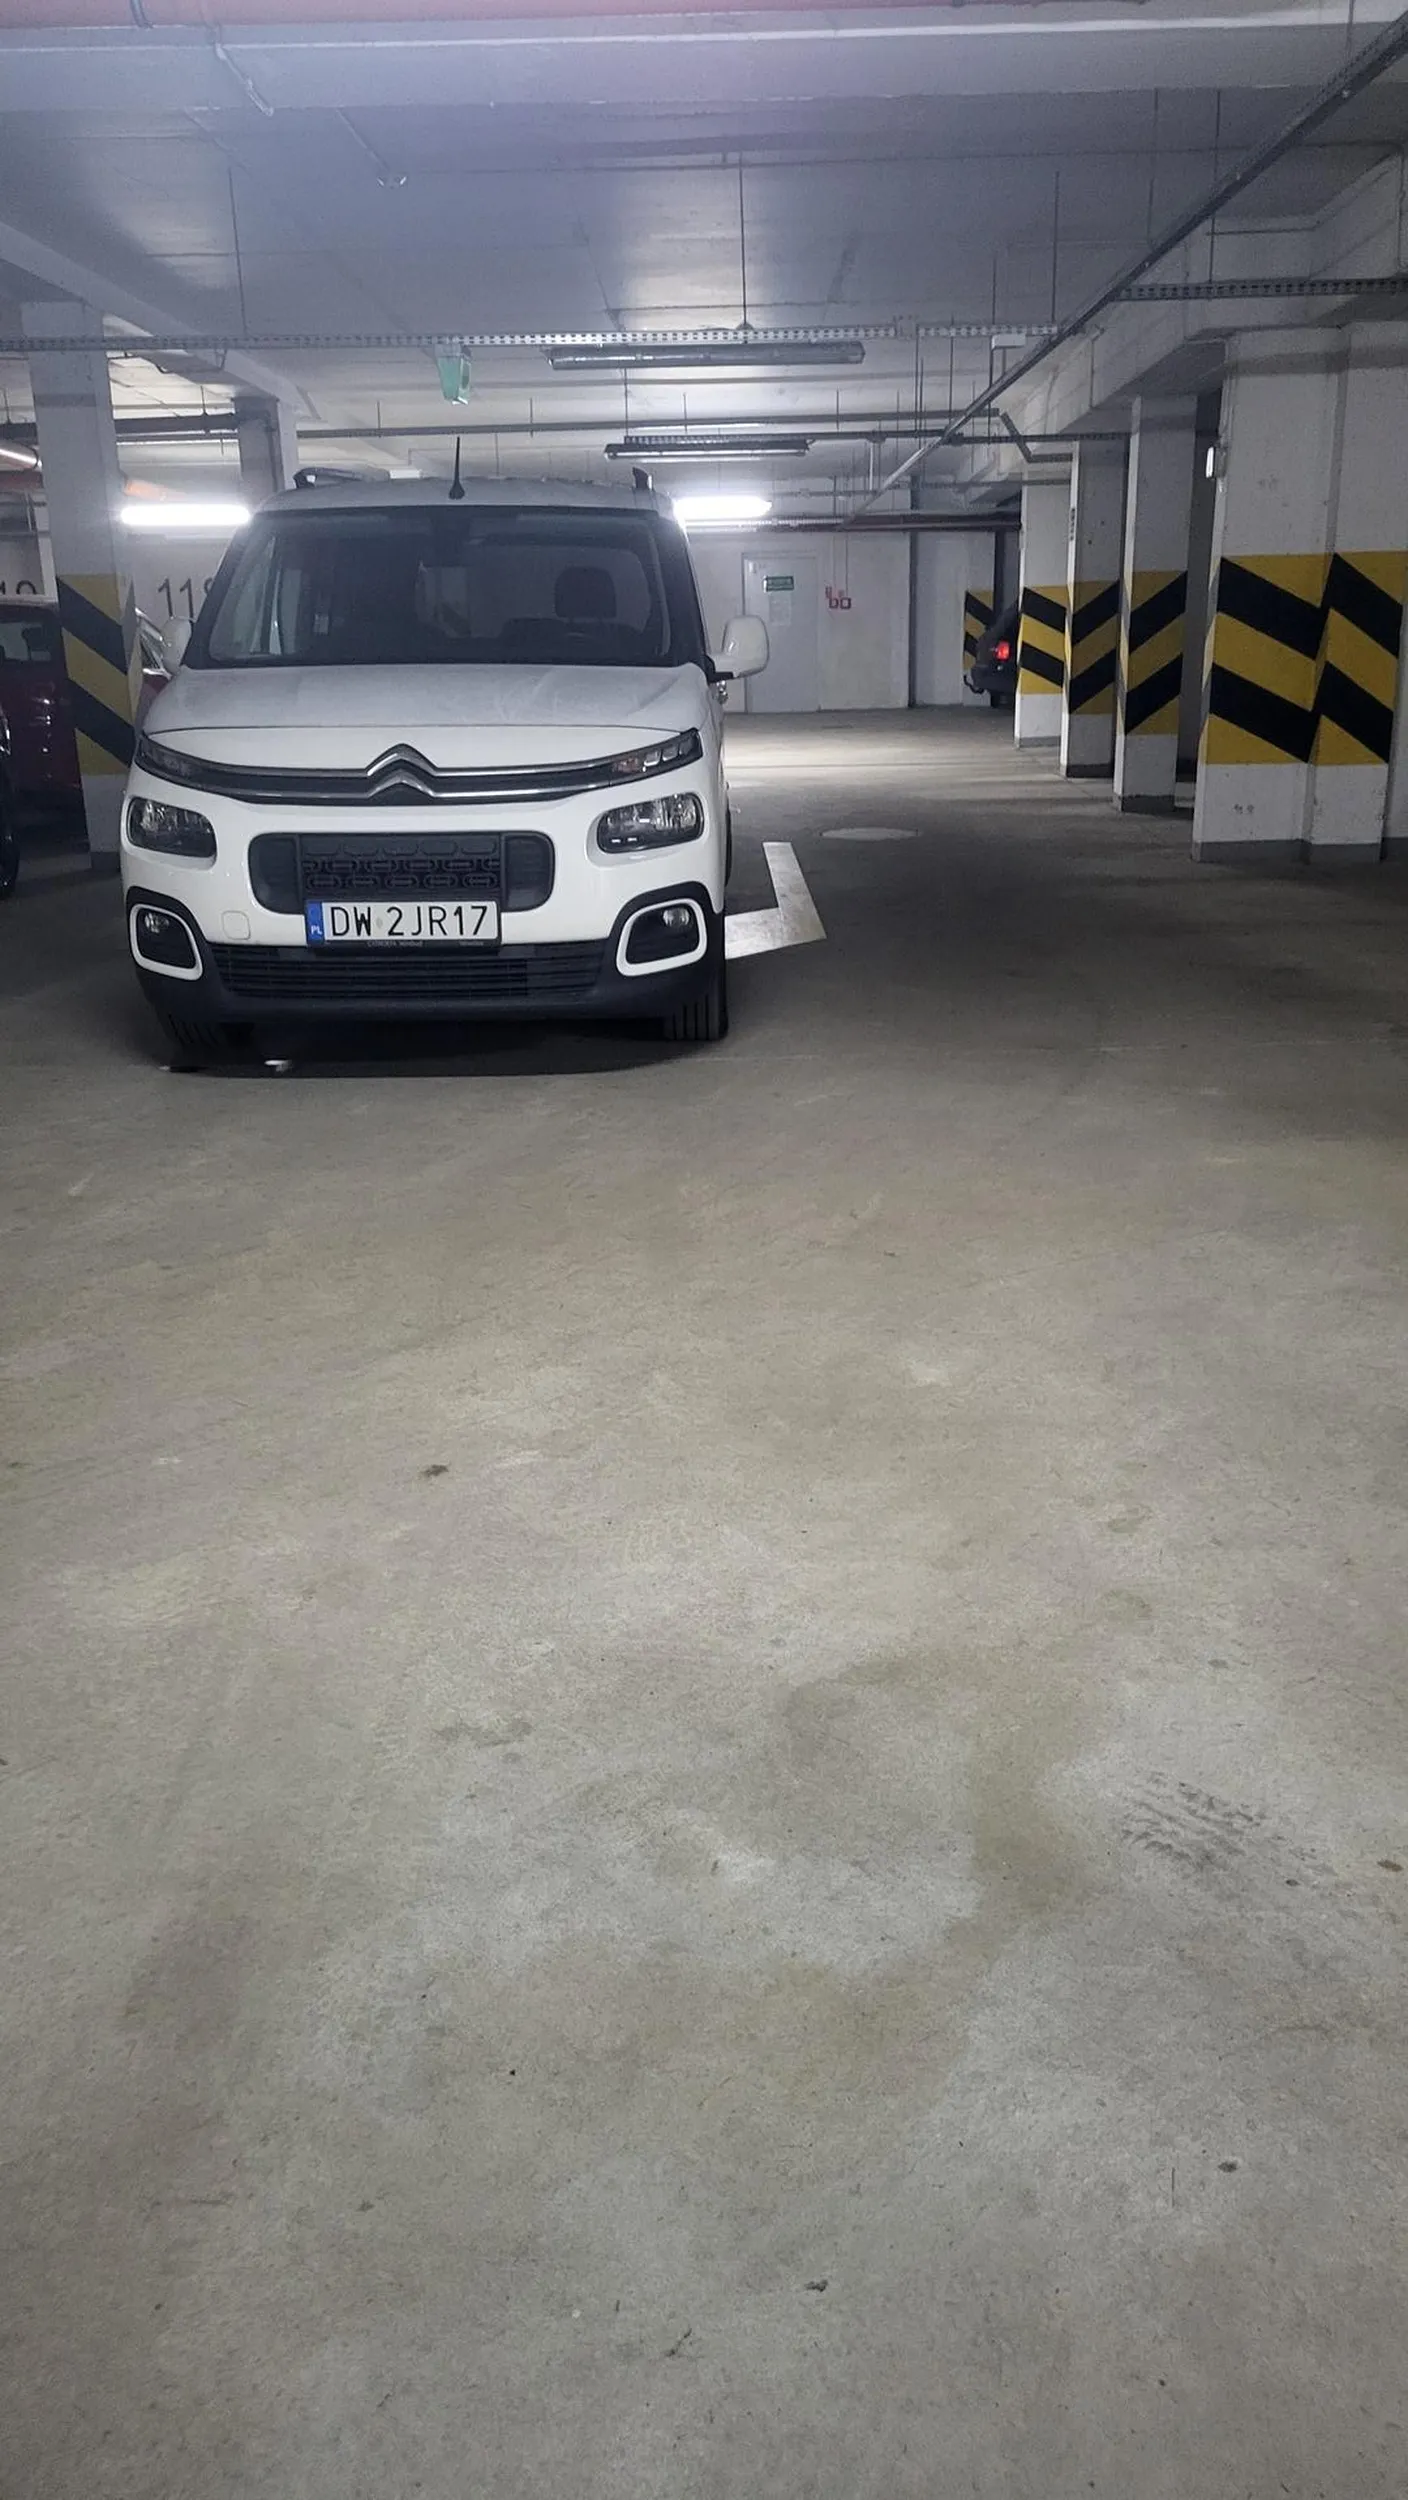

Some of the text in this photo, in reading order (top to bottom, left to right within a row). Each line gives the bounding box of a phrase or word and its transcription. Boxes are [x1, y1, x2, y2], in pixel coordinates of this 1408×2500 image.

[311, 925, 322, 935] PL
[331, 906, 487, 936] DW 2JR17
